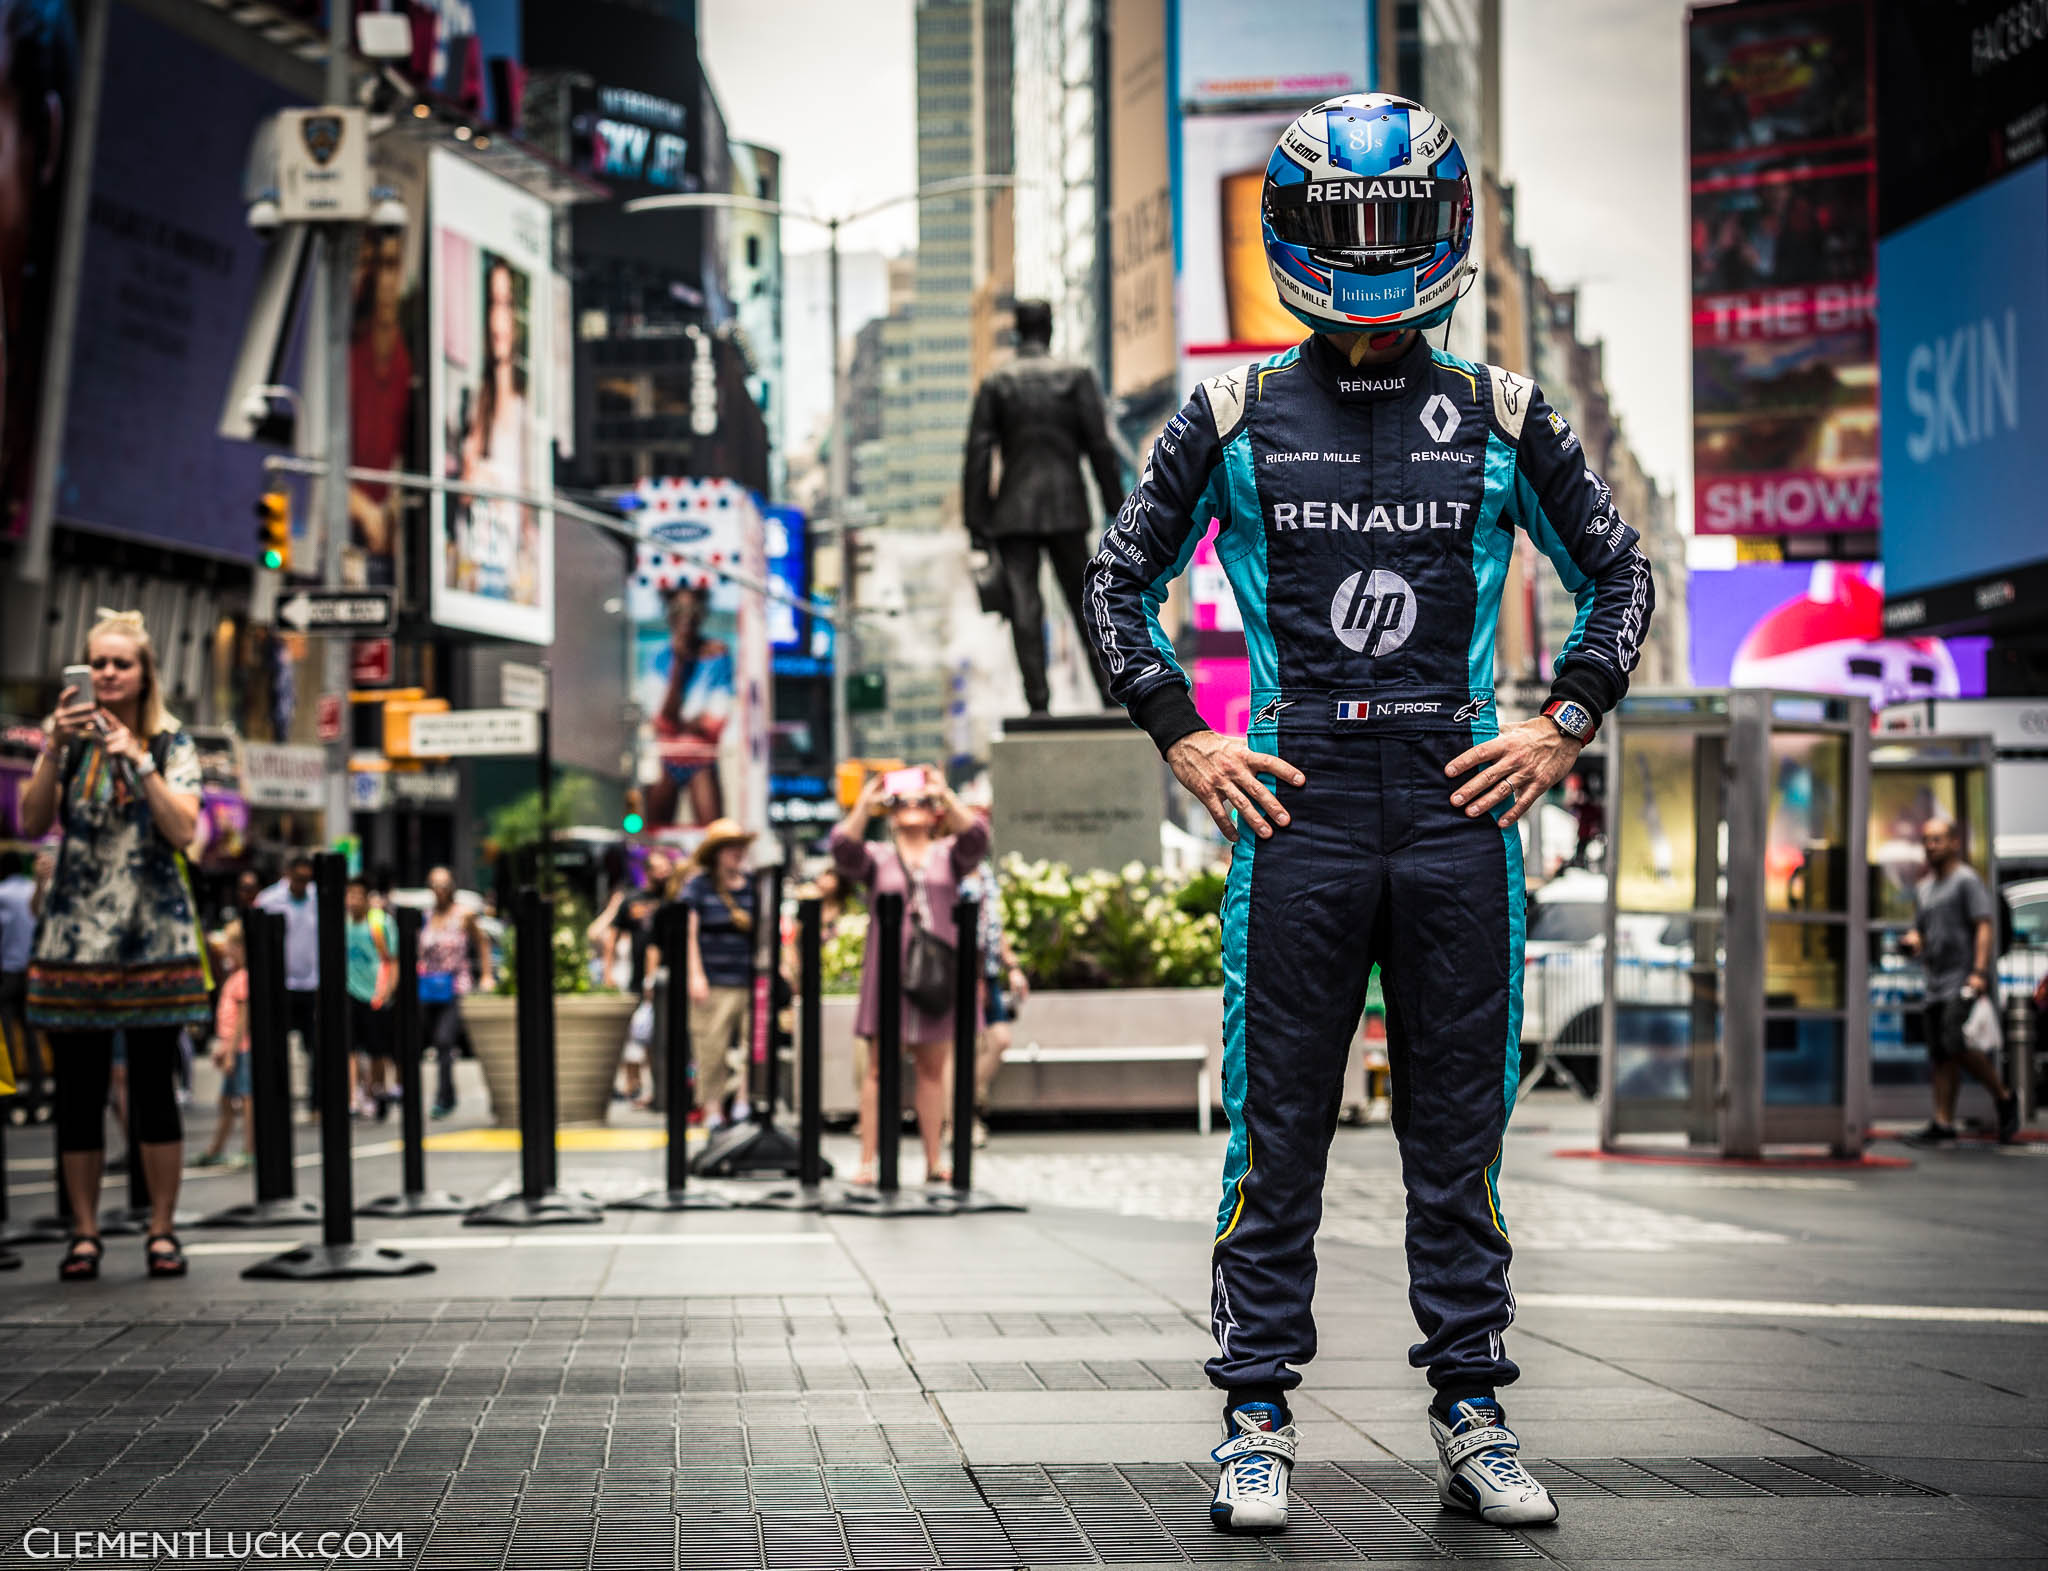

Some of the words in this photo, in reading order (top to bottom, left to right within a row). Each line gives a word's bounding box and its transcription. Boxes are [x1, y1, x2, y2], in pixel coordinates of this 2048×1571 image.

[1290, 139, 1322, 164] LEMO
[1307, 180, 1435, 203] RENAULT
[1274, 267, 1300, 295] RICHARD
[1301, 289, 1328, 309] MILLE
[1342, 287, 1381, 302] Julius
[1383, 285, 1408, 301] Bär
[1419, 279, 1451, 307] RICHARD
[1707, 290, 1806, 341] THE
[1340, 377, 1407, 393] RENAULT
[1905, 306, 2018, 464] SKIN
[1266, 452, 1319, 464] RICHARD
[1323, 452, 1361, 463] MILLE
[1411, 450, 1475, 464] RENAULT
[1273, 501, 1471, 533] RENAULT
[1125, 543, 1148, 566] Bär
[1336, 569, 1412, 656] hp
[1376, 702, 1392, 715] N.
[1394, 702, 1442, 715] PROST
